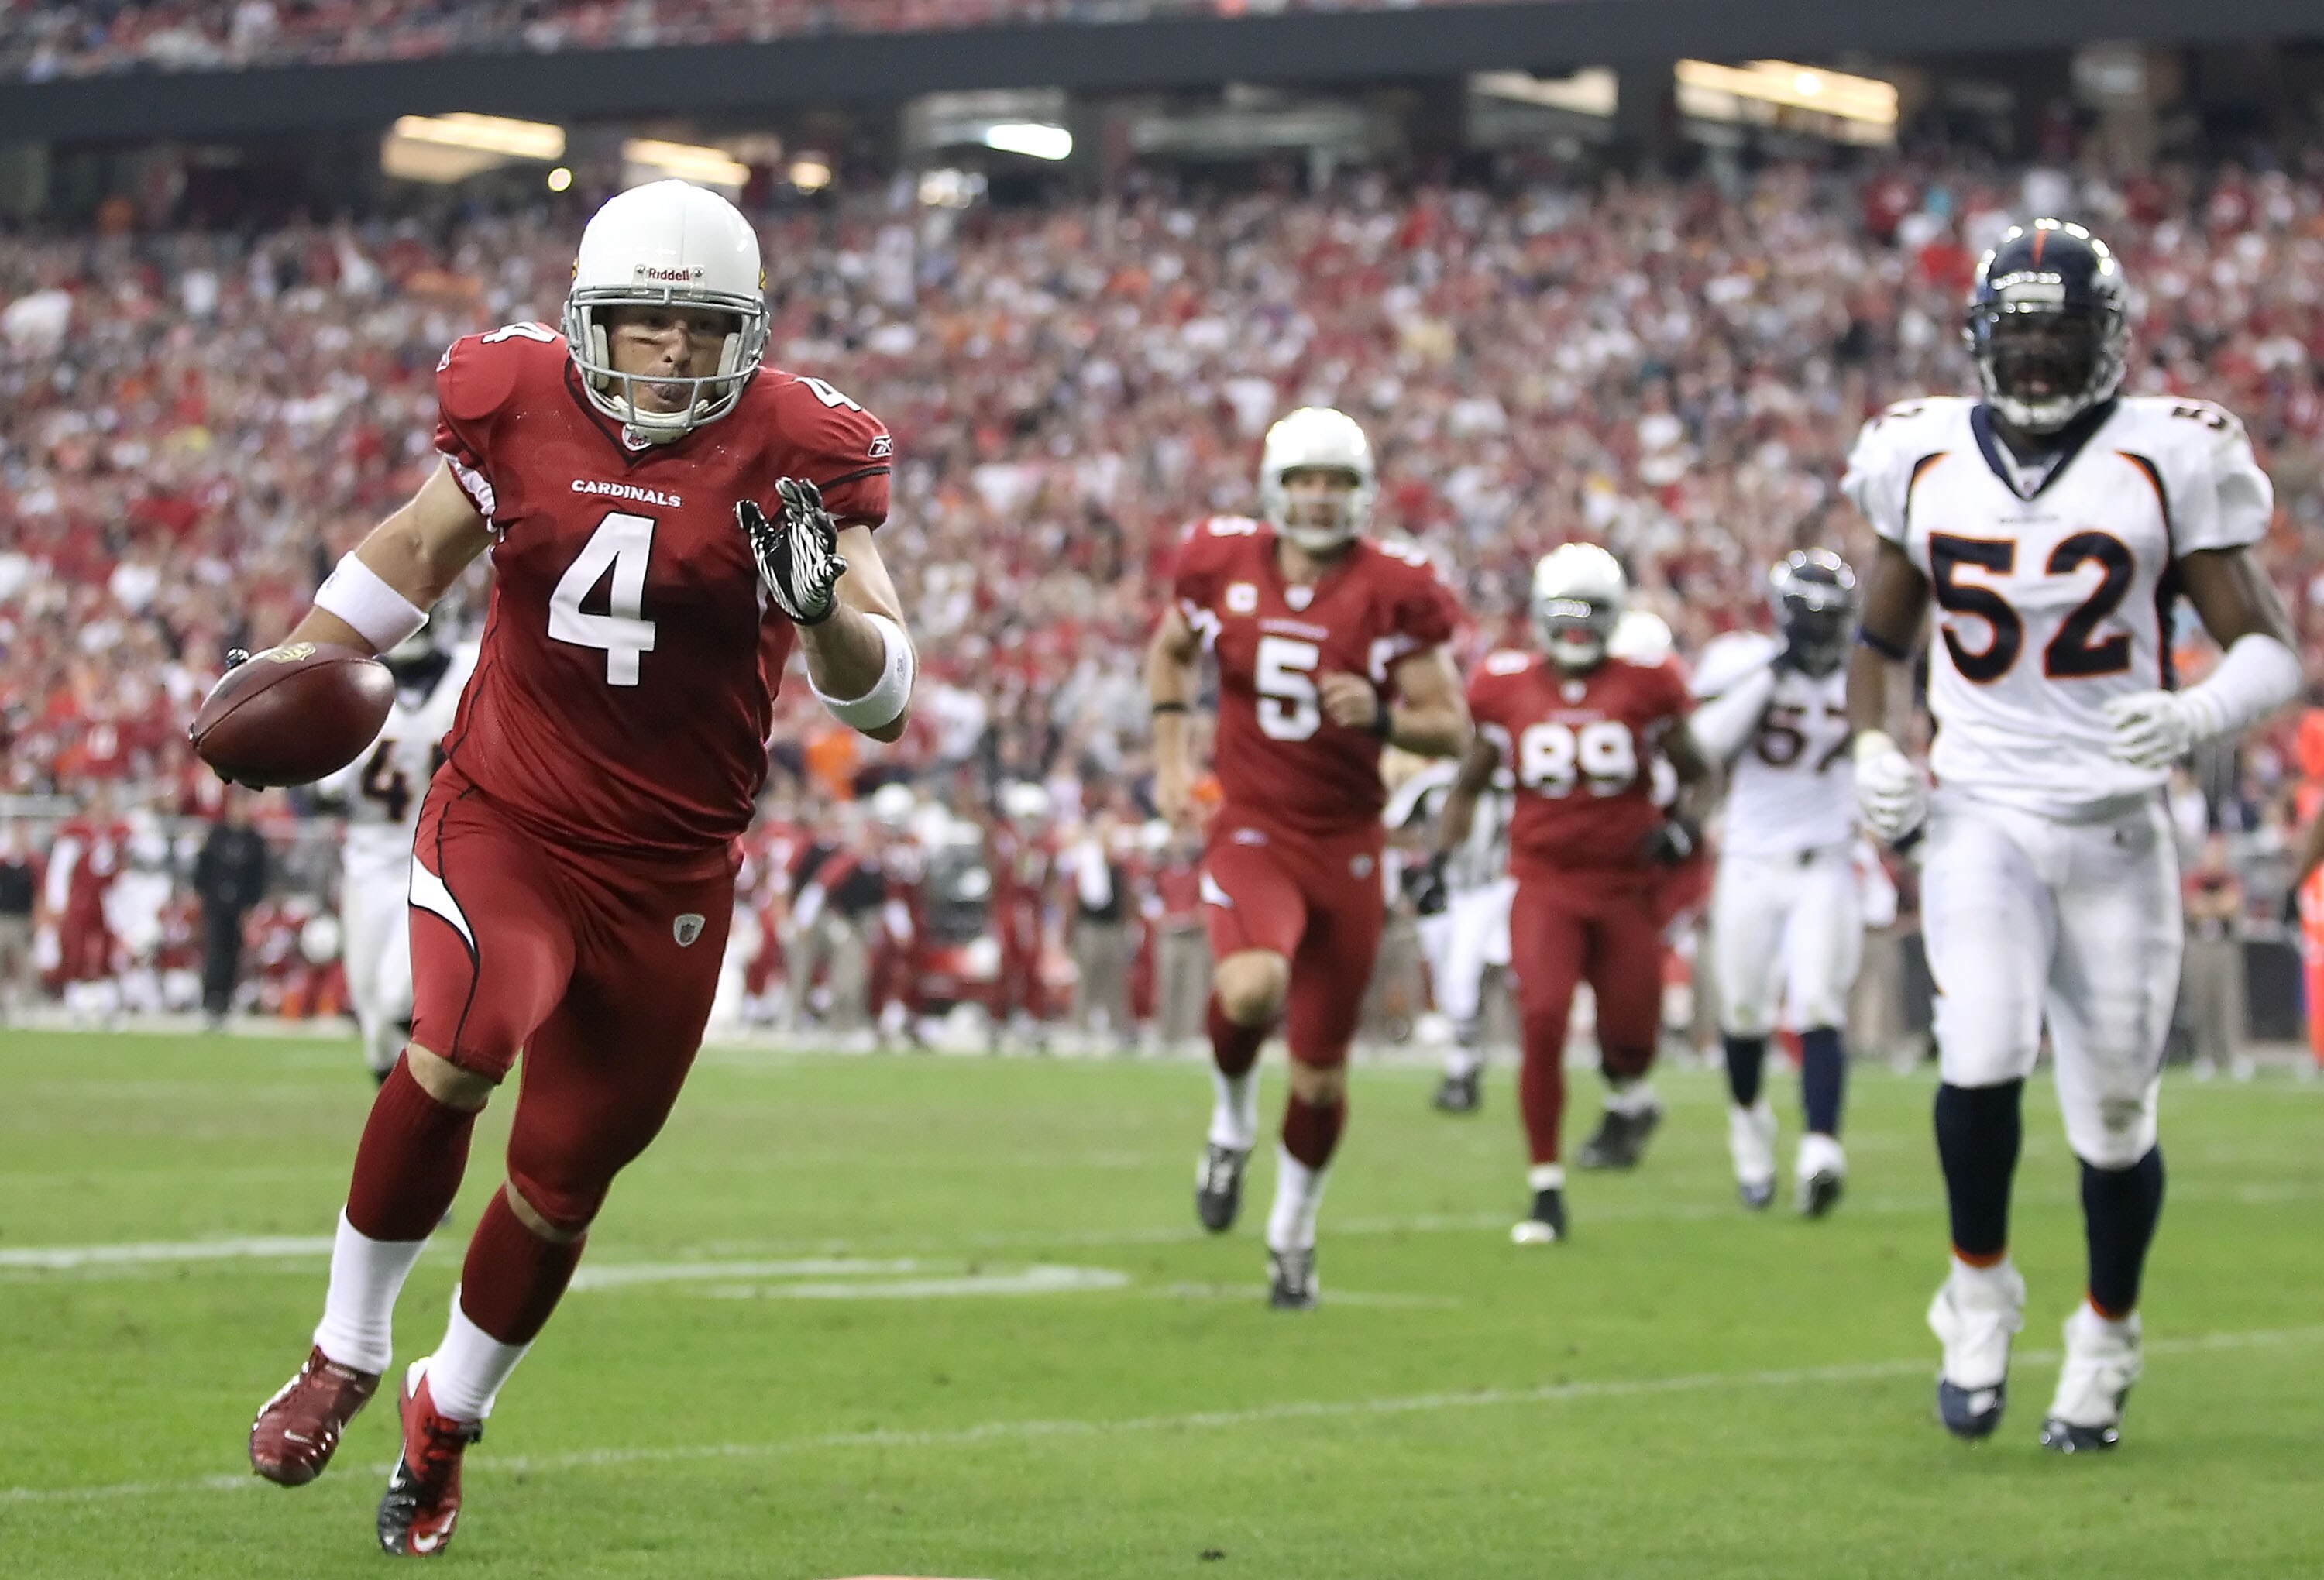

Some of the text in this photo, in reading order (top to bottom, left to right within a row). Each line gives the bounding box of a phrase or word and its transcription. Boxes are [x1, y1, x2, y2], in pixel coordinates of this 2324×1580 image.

[648, 267, 689, 281] Riddell
[571, 479, 682, 508] CARDINALS
[548, 511, 657, 687] 4
[1927, 530, 2136, 685] 52
[1255, 637, 1322, 741] 5
[1519, 720, 1638, 799] 89
